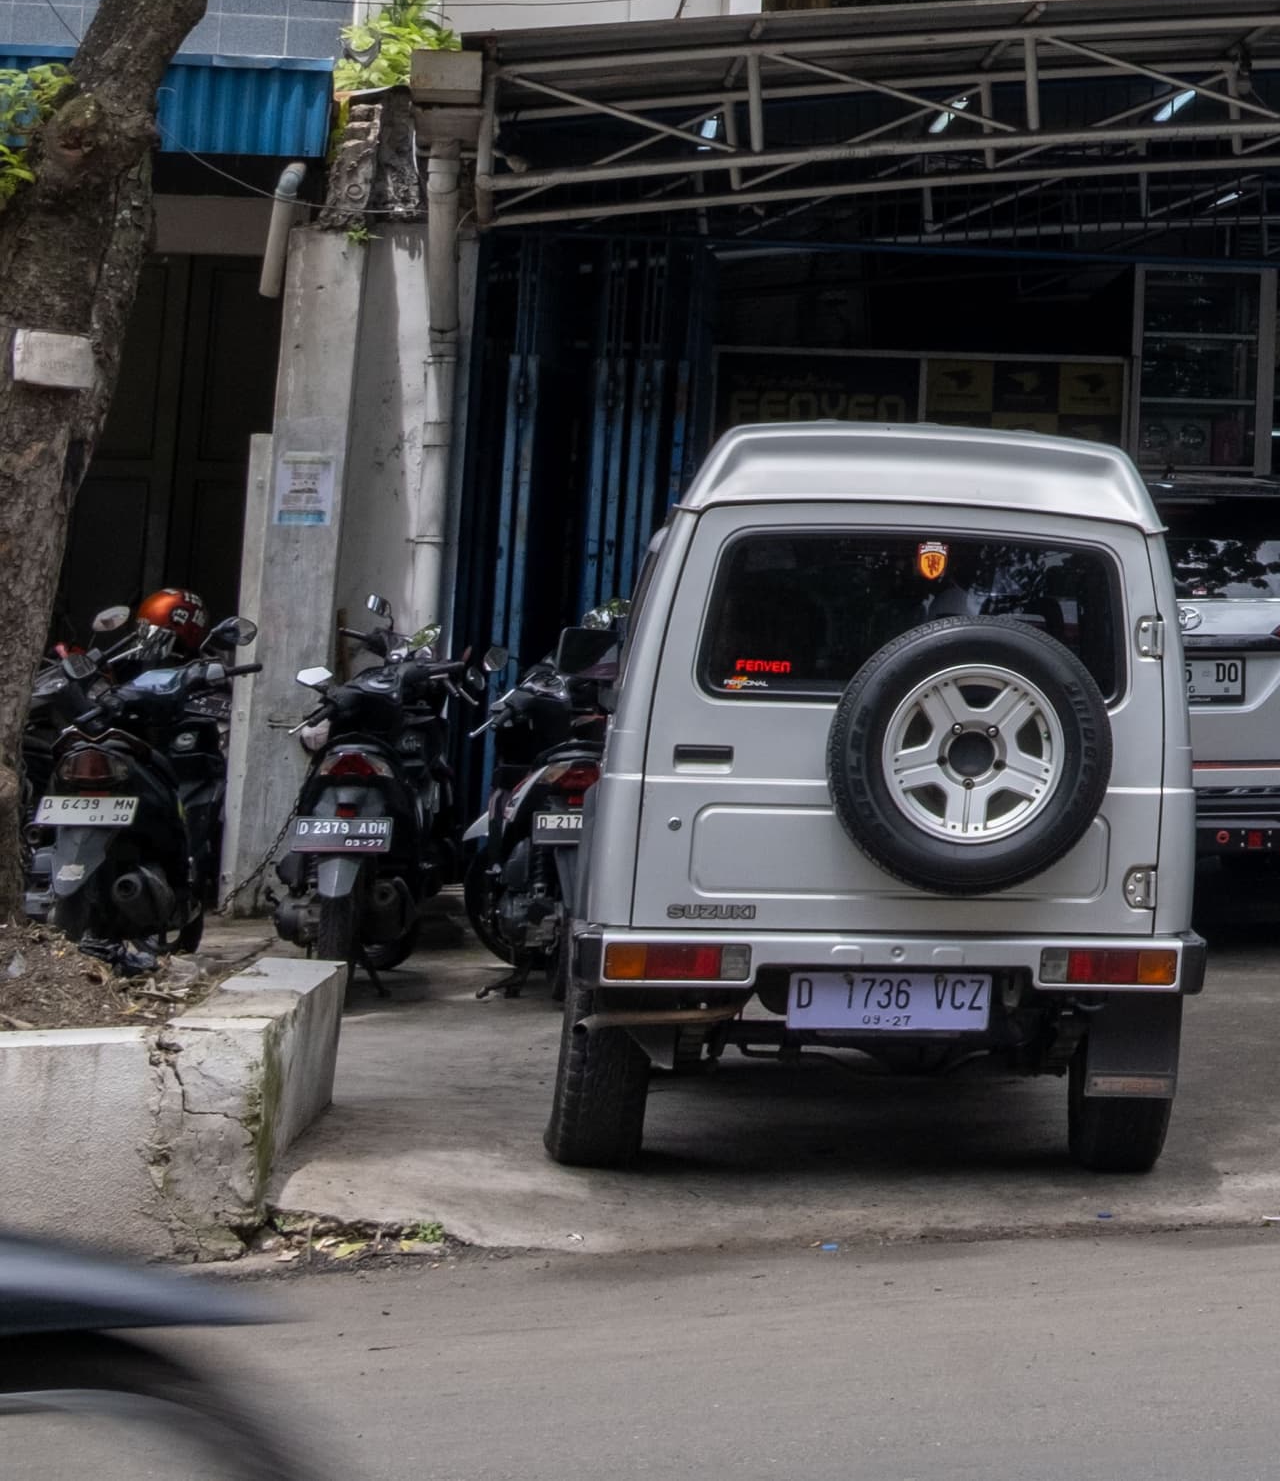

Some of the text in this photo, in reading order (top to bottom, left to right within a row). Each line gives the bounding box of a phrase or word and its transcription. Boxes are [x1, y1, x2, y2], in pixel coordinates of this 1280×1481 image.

[735, 659, 792, 673] FENYEN
[1215, 662, 1239, 683] DO
[113, 798, 135, 811] MN
[299, 821, 388, 835] D 2379 ADH
[556, 815, 583, 829] 217
[666, 904, 756, 920] SUZUKI
[796, 976, 985, 1011] D 1736 VCZ
